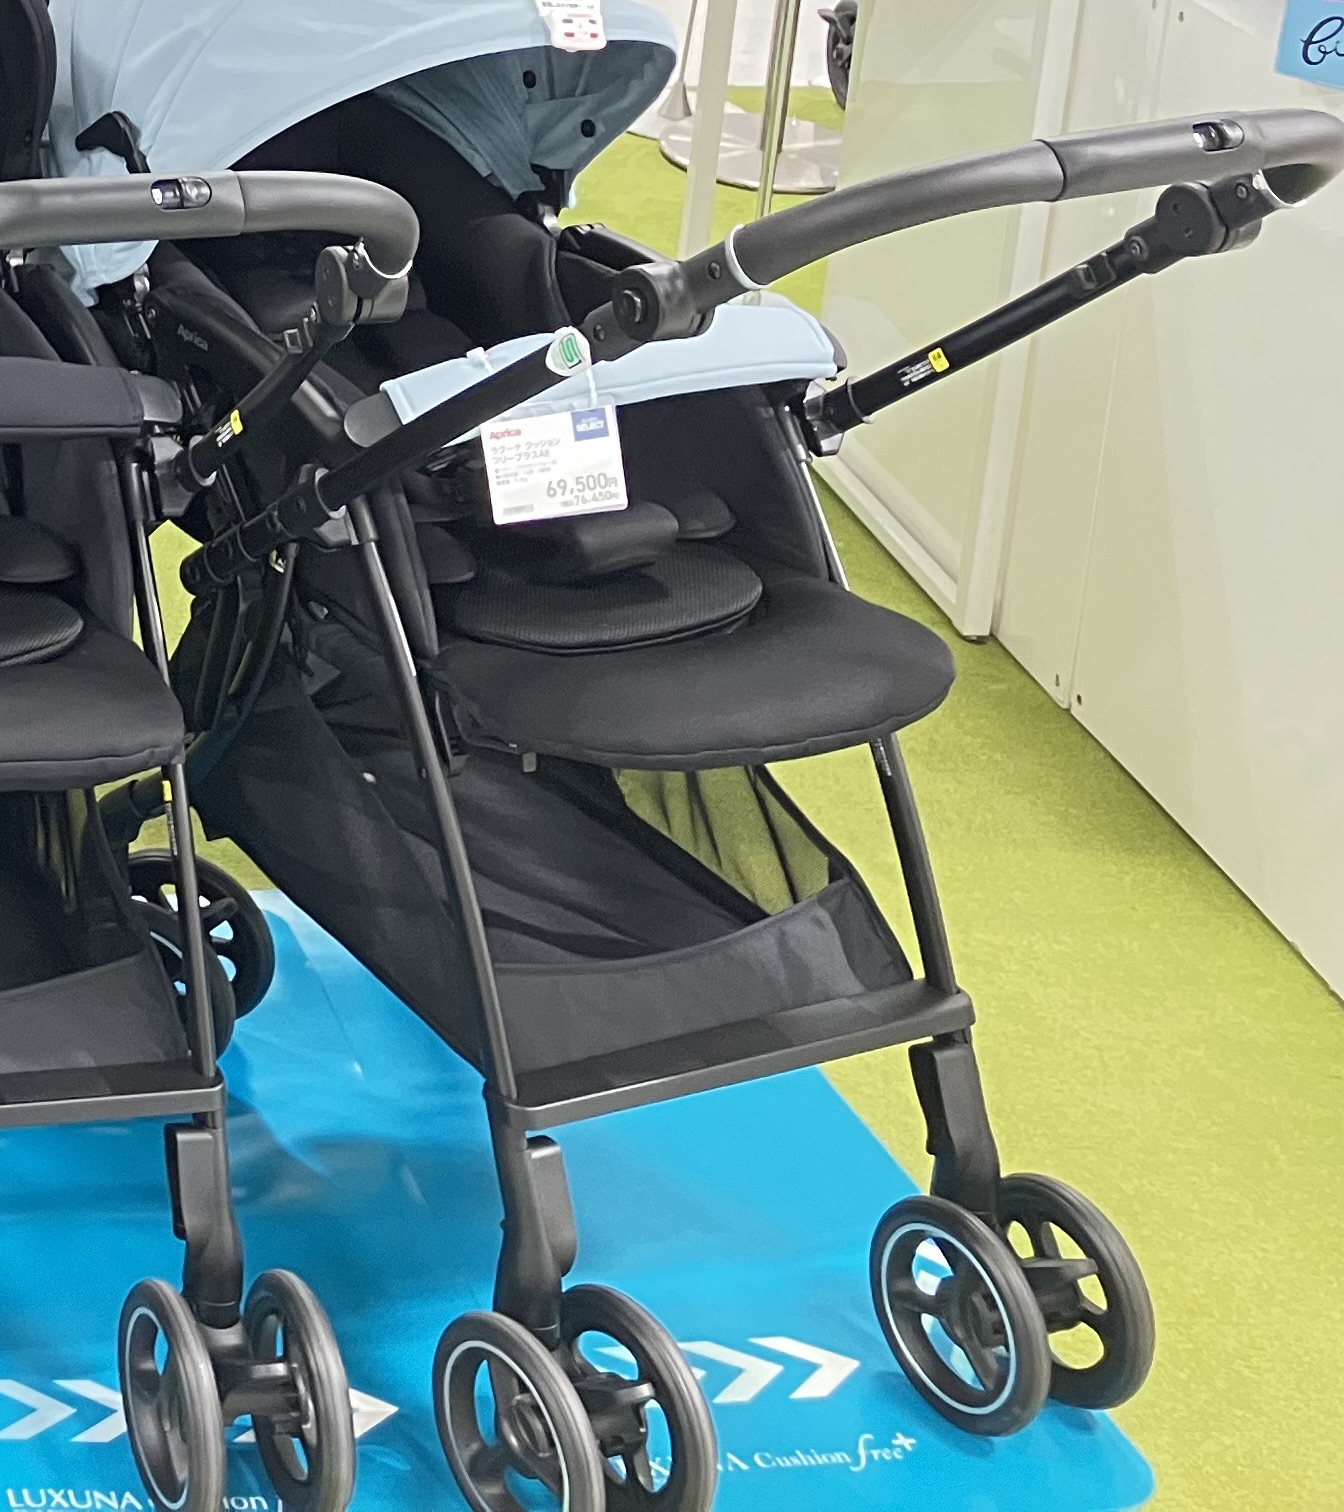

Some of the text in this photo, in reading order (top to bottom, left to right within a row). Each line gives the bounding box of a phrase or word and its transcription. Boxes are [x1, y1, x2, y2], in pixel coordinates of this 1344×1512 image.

[489, 428, 522, 442] Aprica
[546, 472, 618, 498] 69,500円
[754, 1444, 851, 1471] Cushion
[6, 1488, 144, 1512] LUXUNA
